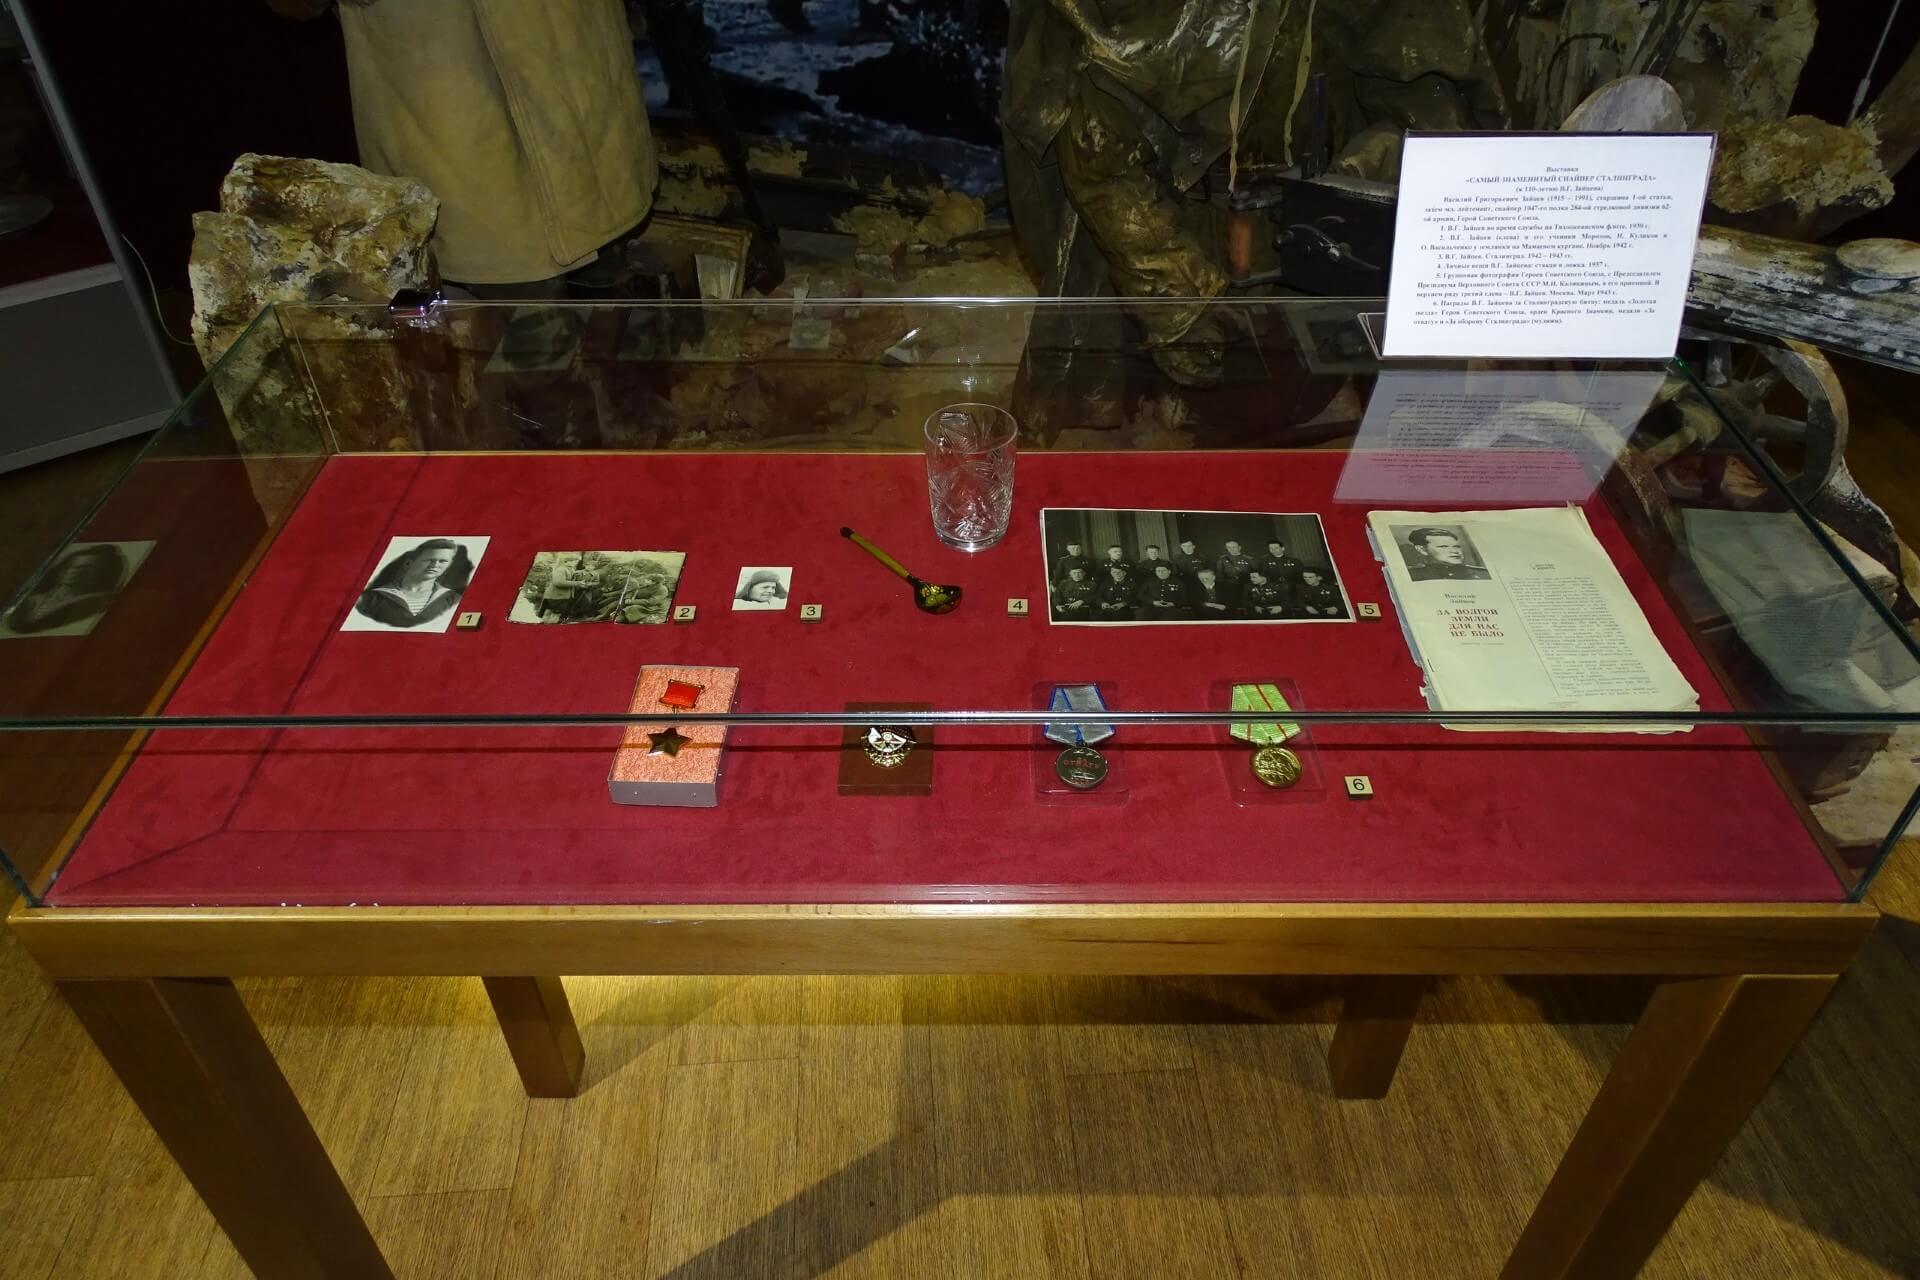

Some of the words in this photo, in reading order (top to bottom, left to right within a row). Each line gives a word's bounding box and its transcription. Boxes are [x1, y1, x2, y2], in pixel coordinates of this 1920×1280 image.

[1502, 175, 1557, 183] ЗНАМЕНИТЫЙ
[1013, 601, 1023, 610] 4
[1364, 605, 1375, 615] 5
[679, 607, 690, 618] 2
[806, 606, 816, 616] 3
[1436, 608, 1451, 616] ЗА
[466, 614, 473, 624] 1
[1352, 778, 1365, 791] 6
